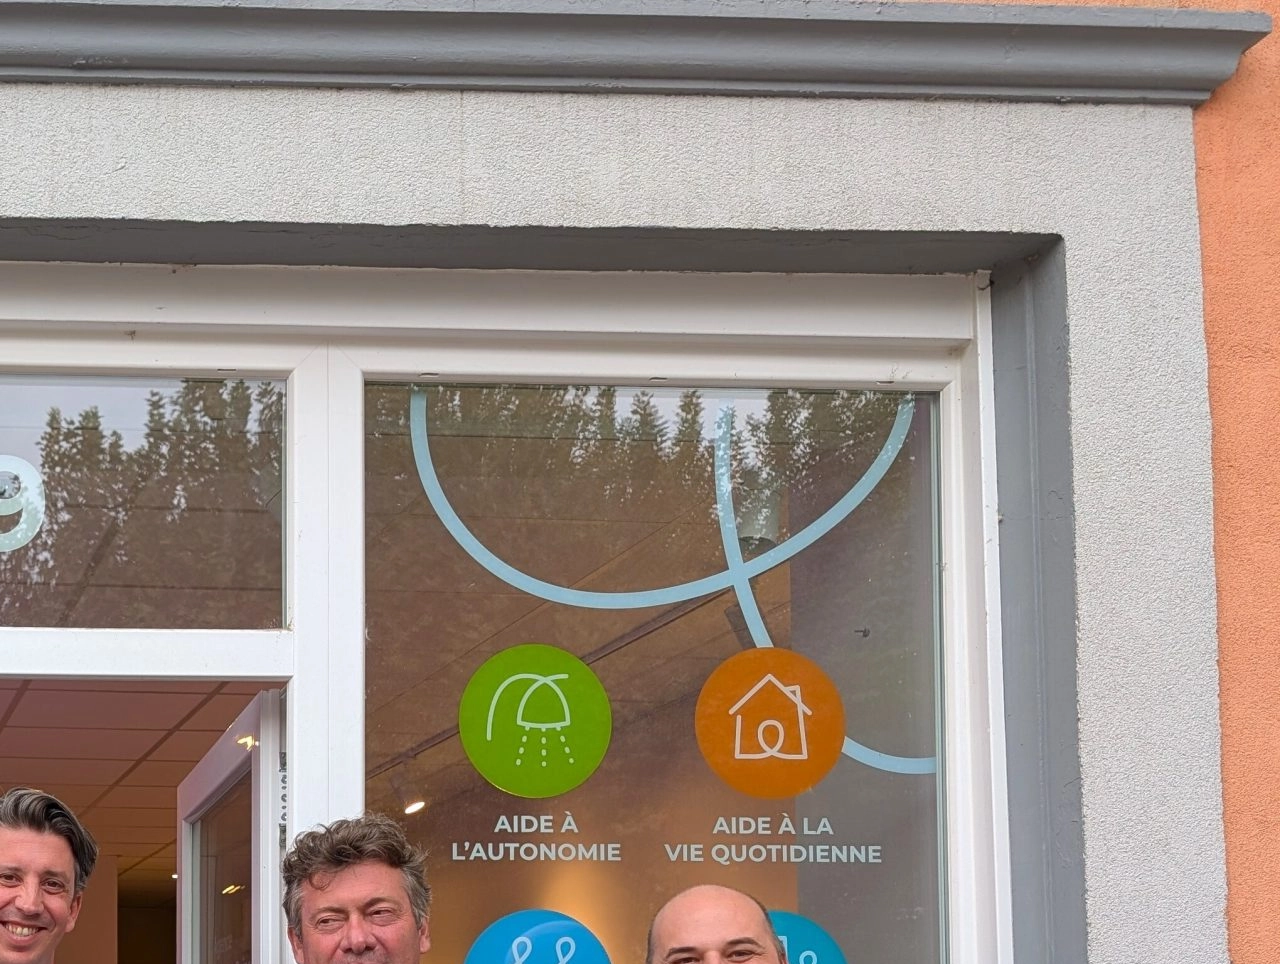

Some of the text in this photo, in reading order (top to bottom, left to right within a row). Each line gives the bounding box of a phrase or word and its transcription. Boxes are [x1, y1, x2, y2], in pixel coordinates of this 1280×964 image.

[494, 811, 579, 834] AIDE À
[712, 812, 834, 836] AIDE À LA
[451, 842, 622, 862] L'AUTONOMIE
[664, 844, 882, 867] VIE QUOTIDIENNE
